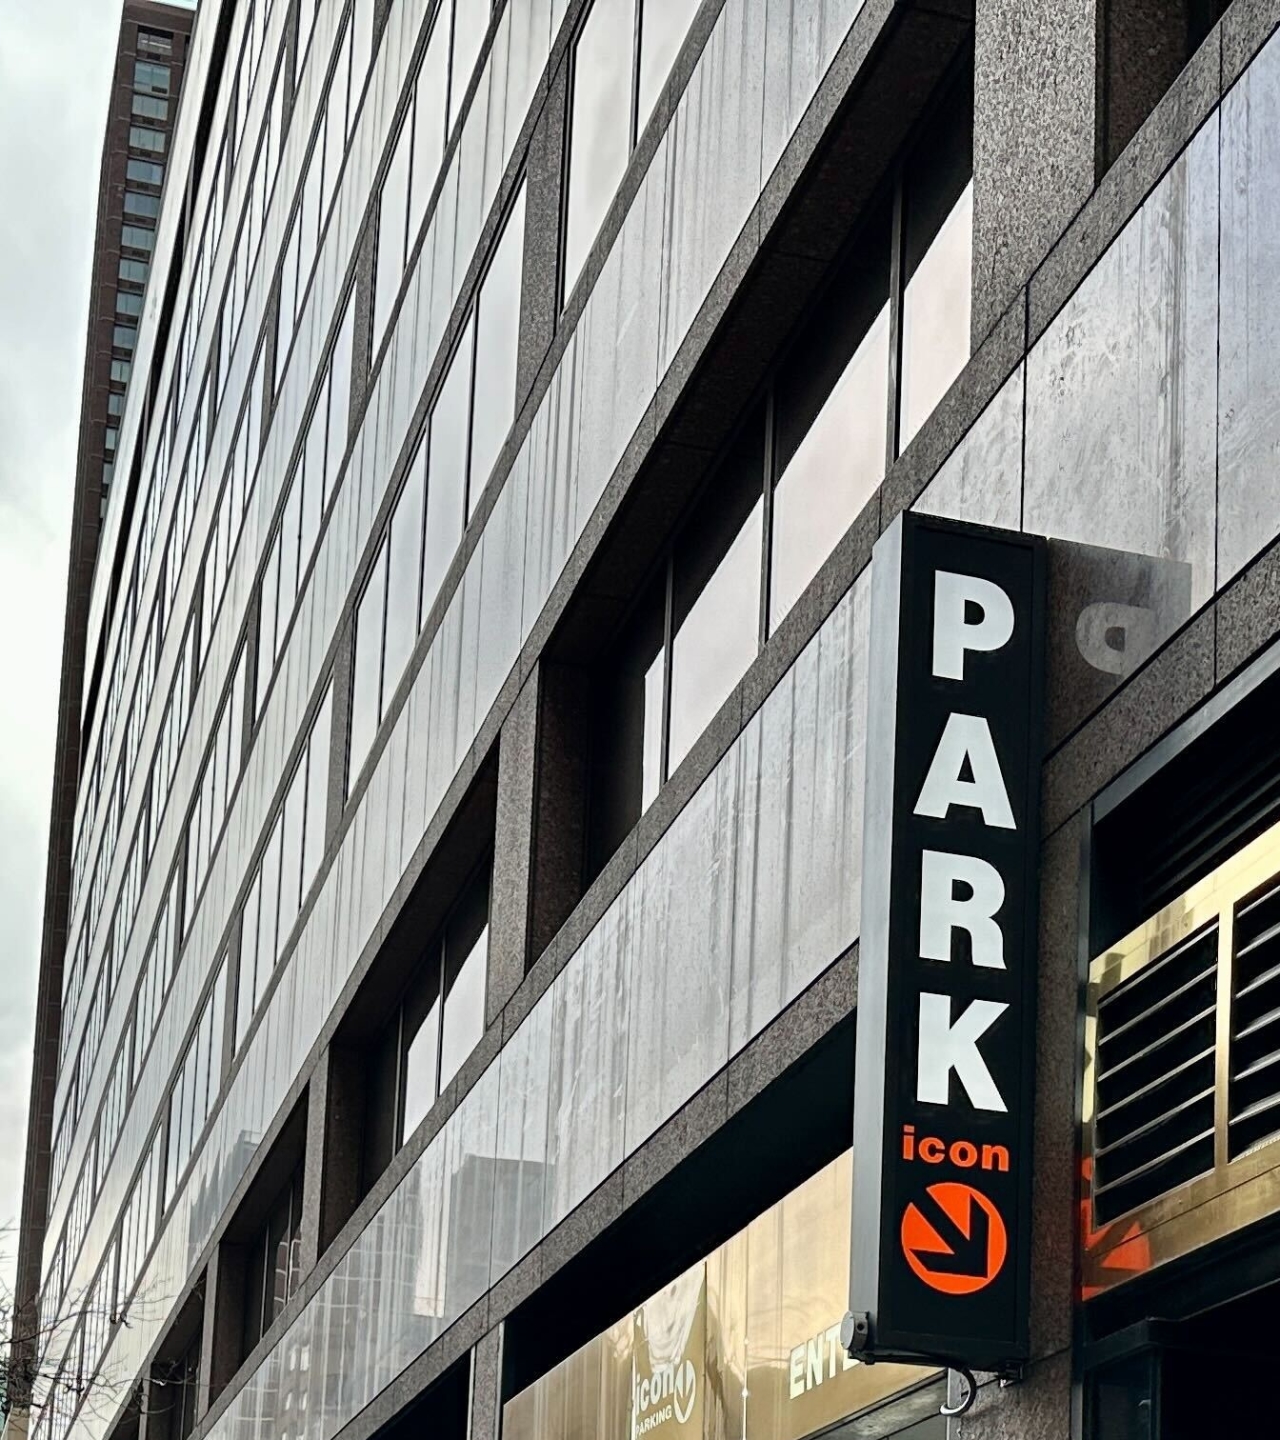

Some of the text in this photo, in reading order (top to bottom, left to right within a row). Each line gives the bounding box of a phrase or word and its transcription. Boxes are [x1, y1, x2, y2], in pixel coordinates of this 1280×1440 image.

[912, 569, 1017, 1114] PARK
[902, 1125, 1010, 1172] icon
[635, 1404, 673, 1440] PARKING
